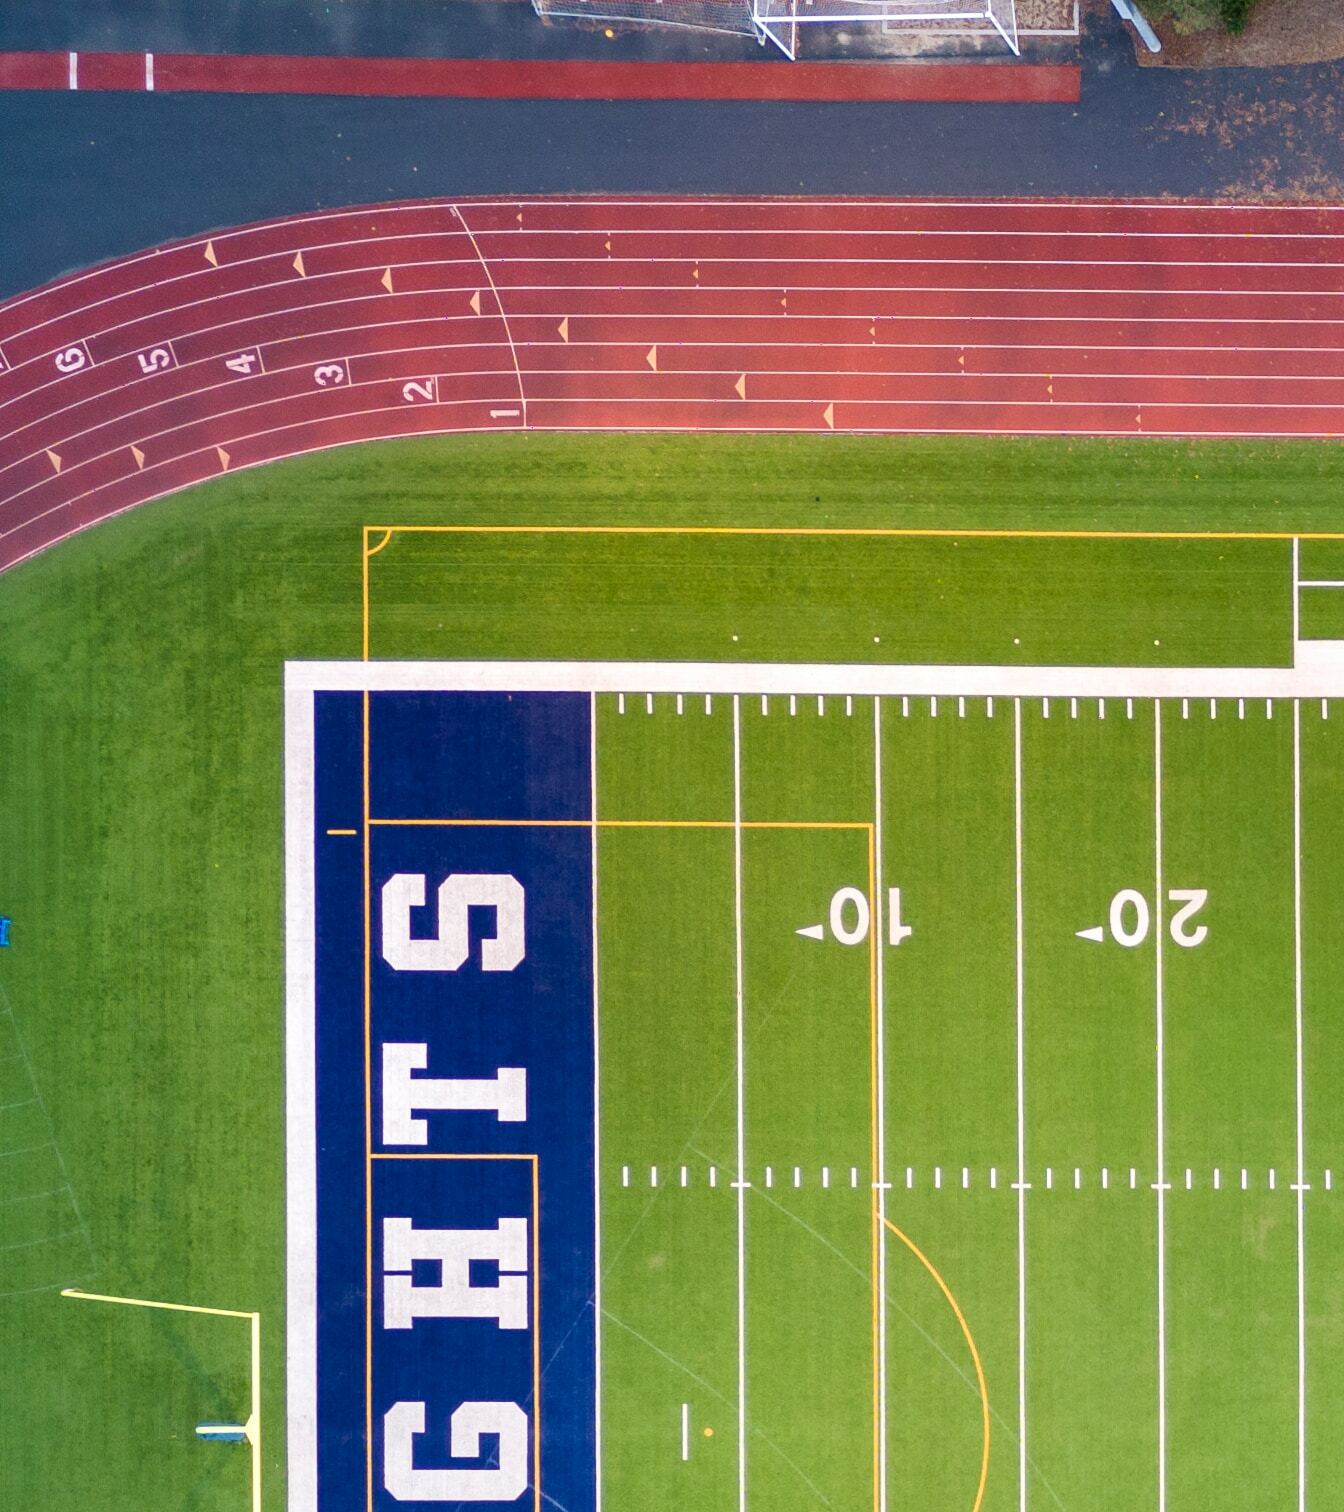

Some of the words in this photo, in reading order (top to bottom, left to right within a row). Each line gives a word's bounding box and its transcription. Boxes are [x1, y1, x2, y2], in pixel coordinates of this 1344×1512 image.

[55, 347, 85, 372] 6
[137, 348, 170, 373] 5
[225, 354, 256, 374] 4
[314, 364, 344, 386] 3
[402, 380, 433, 401] 2
[490, 409, 520, 419] 1
[829, 887, 913, 946] 10
[1108, 889, 1209, 948] 20
